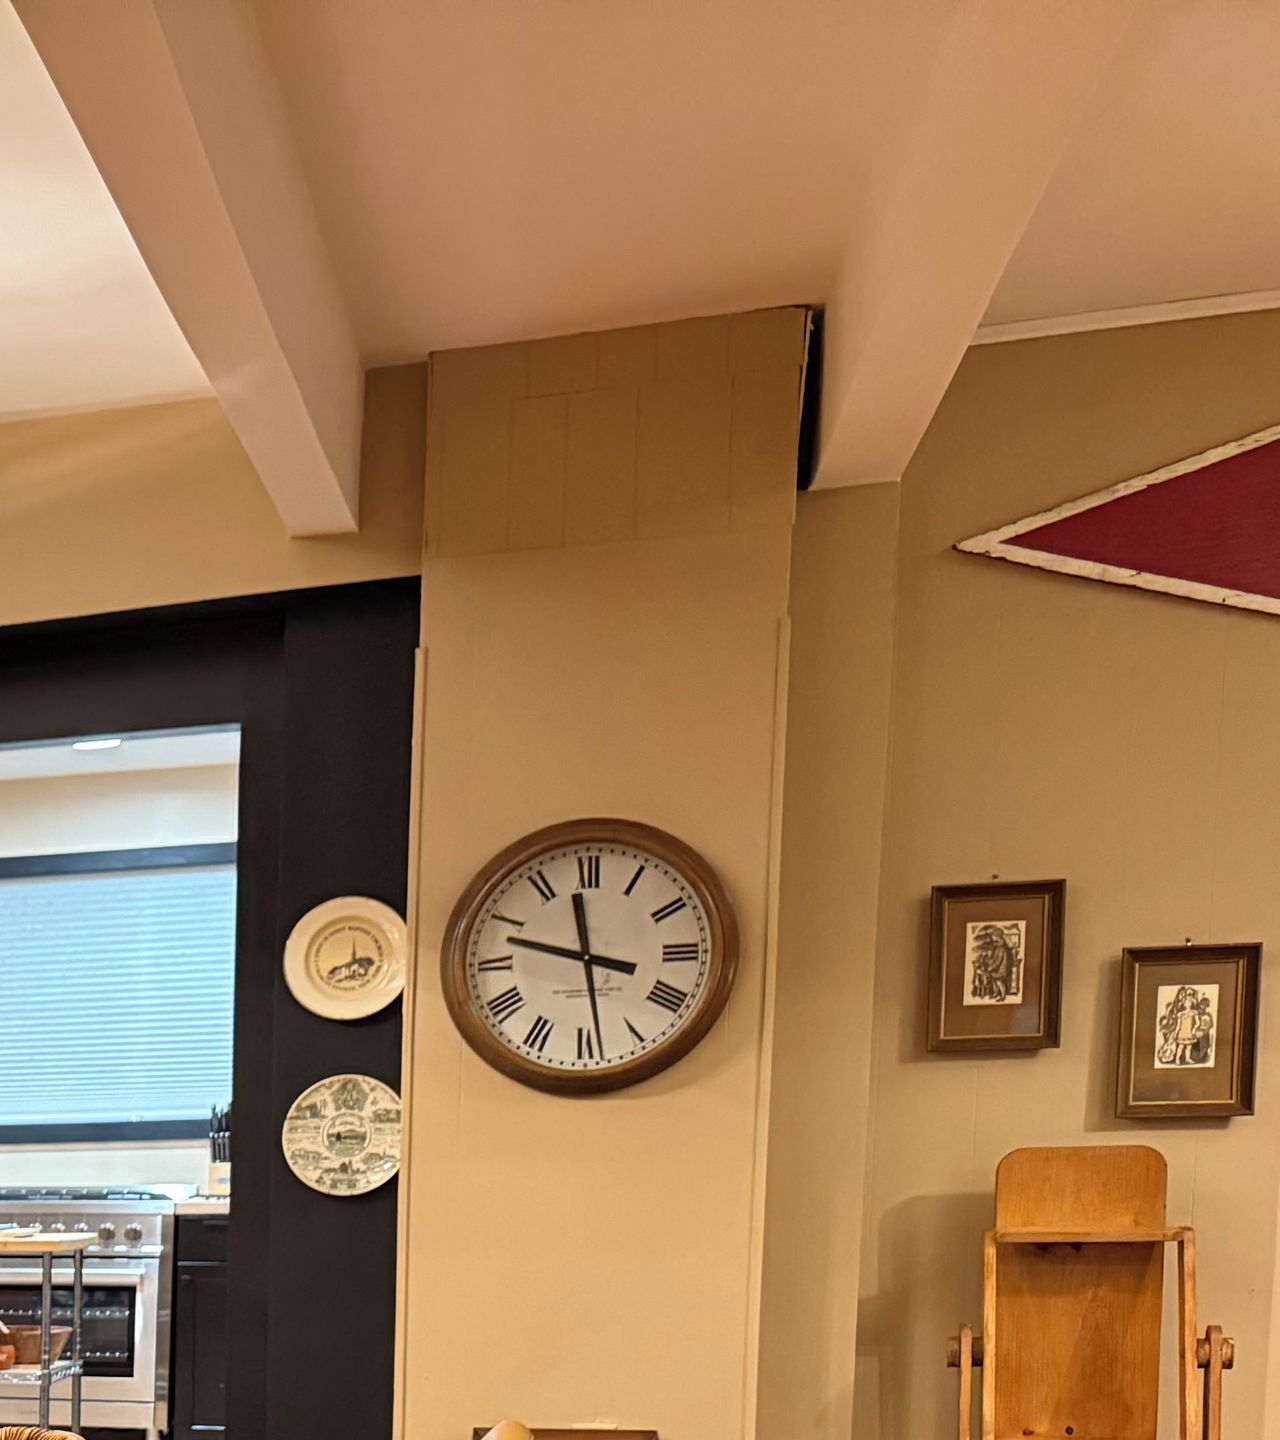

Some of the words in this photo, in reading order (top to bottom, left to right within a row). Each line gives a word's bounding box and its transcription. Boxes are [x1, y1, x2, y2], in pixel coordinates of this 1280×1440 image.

[576, 855, 600, 890] XII
[623, 864, 645, 896] I
[650, 896, 687, 925] II
[661, 943, 699, 962] III
